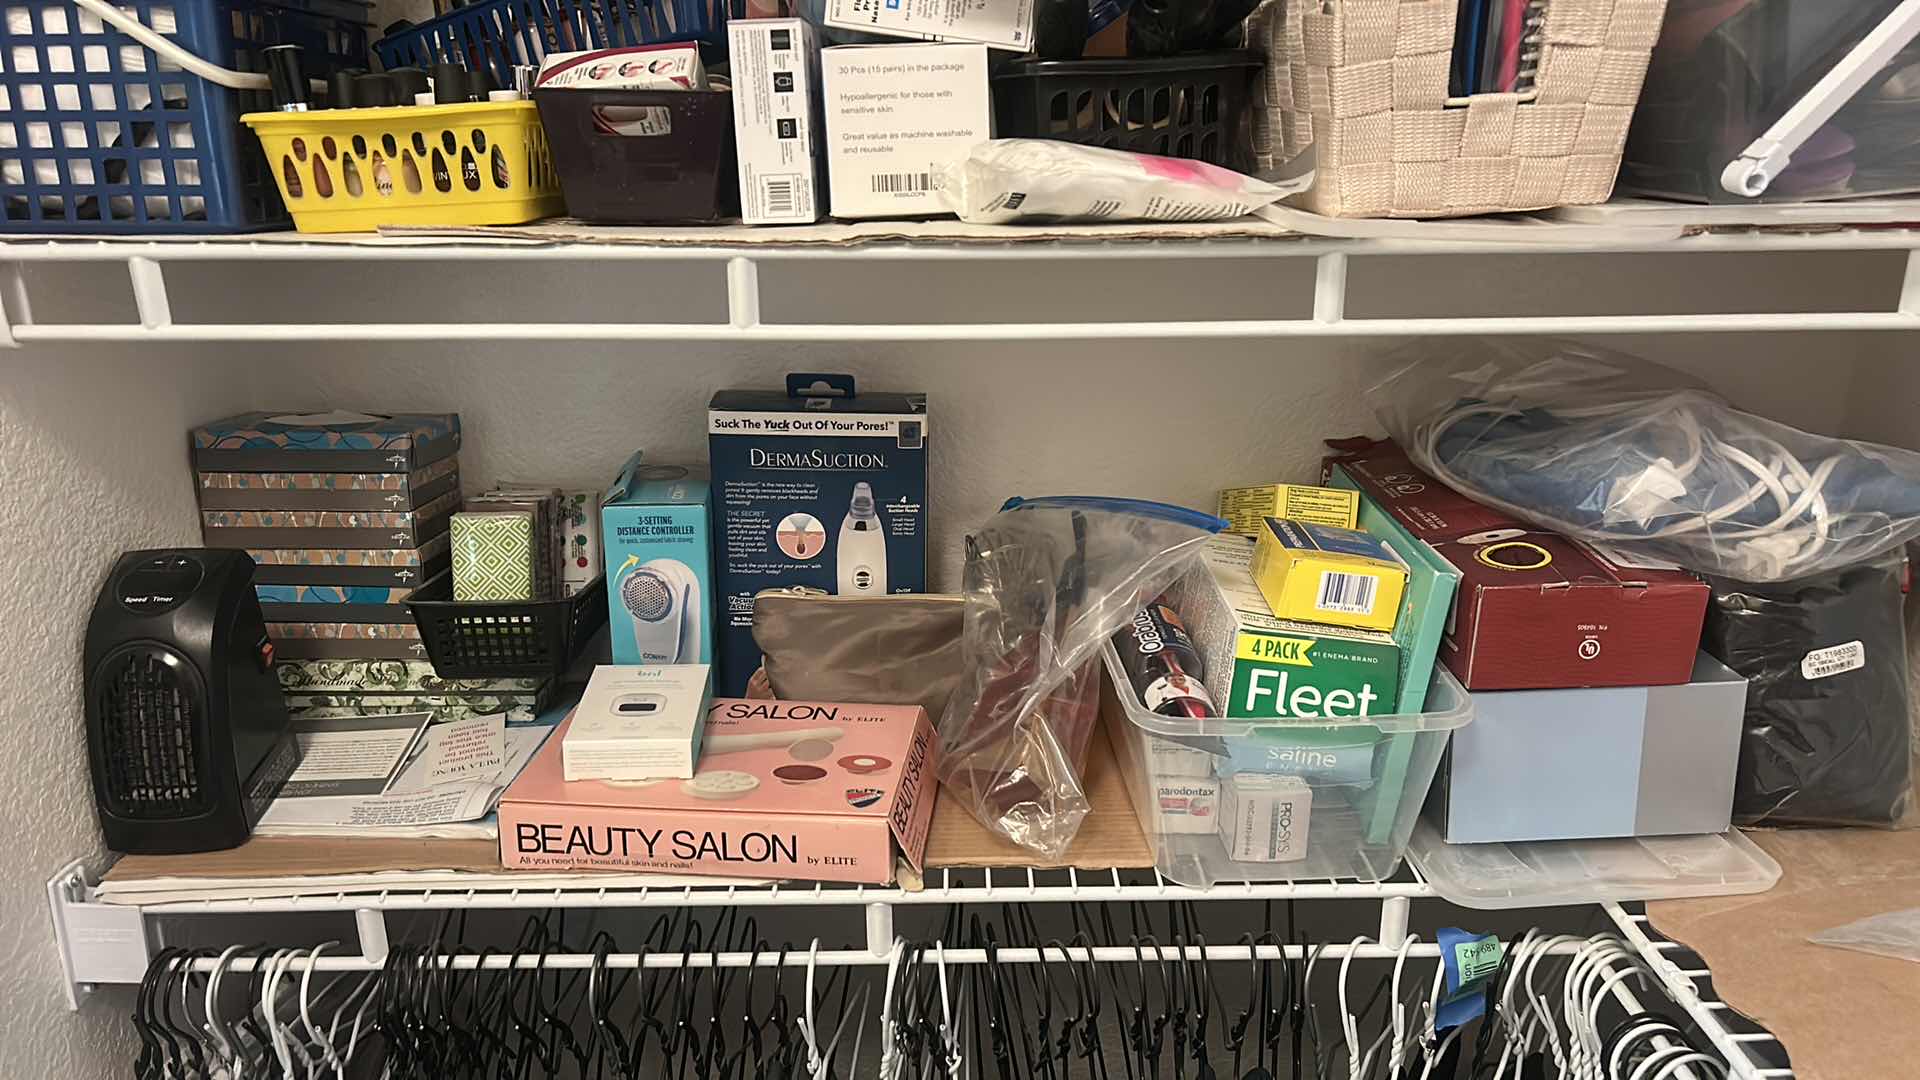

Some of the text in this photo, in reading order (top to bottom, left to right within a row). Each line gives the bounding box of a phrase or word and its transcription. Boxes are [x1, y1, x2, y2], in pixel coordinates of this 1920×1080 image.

[839, 66, 848, 74] 30
[851, 66, 865, 74] Pcs
[883, 64, 906, 74] pairs)
[907, 64, 914, 72] in
[916, 64, 929, 72] the
[931, 63, 964, 74] package
[841, 92, 898, 102] Hypoallergenic
[900, 91, 910, 99] for
[841, 106, 875, 114] sensitive
[842, 133, 864, 141] Great
[901, 131, 934, 139] machine
[844, 146, 857, 154] and
[715, 419, 740, 429] Suck
[742, 420, 760, 429] The
[764, 420, 789, 430] Yuck
[793, 420, 812, 430] Out
[815, 420, 829, 430] Of
[830, 421, 854, 430] Your
[638, 516, 672, 525] 3-SETTING
[617, 526, 694, 535] DISTANCE CONTROLLER
[124, 596, 148, 604] Speed
[1252, 639, 1300, 659] 4 PACK
[1352, 655, 1378, 664] BRAND
[299, 676, 368, 689] Handmade
[1246, 668, 1378, 718] Fleet
[727, 704, 839, 720] SALON
[438, 754, 473, 764] product
[1268, 748, 1337, 768] saline
[893, 776, 913, 834] BEAUTY
[908, 732, 929, 778] SALON
[516, 824, 856, 866] BEAUTY SALON by ELITE
[520, 856, 530, 864] All
[533, 858, 550, 866] you
[590, 858, 630, 866] beautiful
[631, 859, 649, 867] skin
